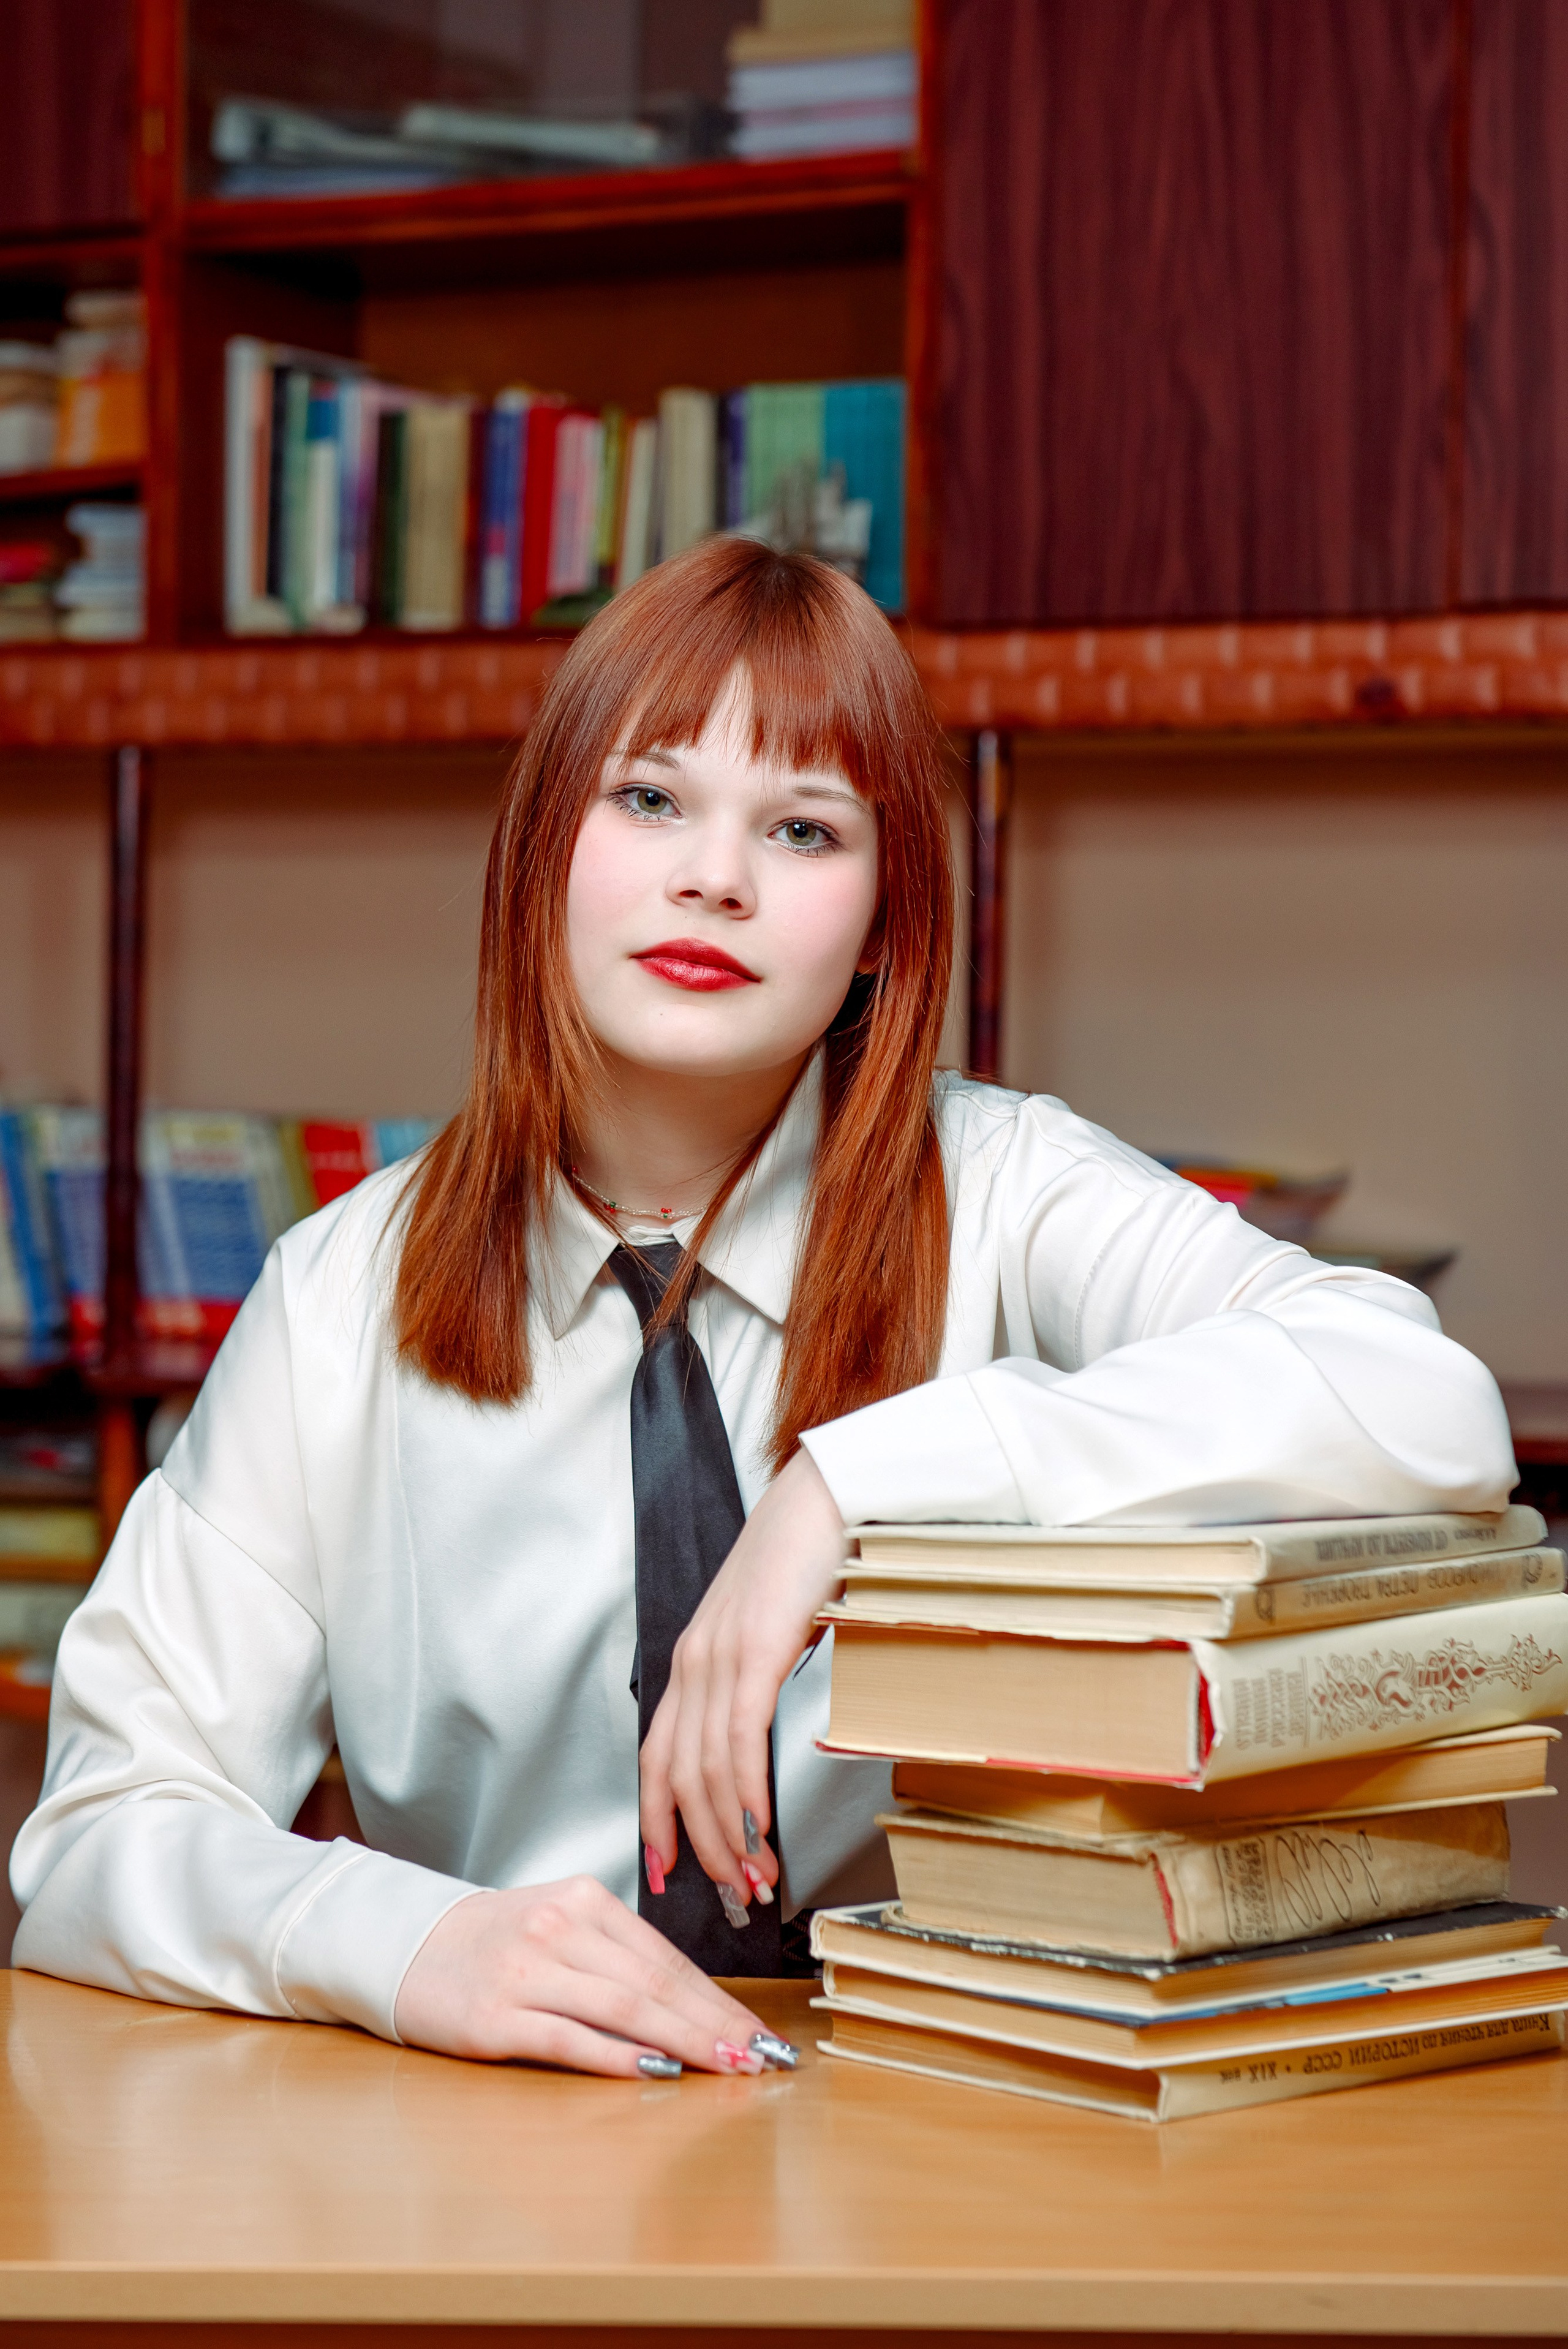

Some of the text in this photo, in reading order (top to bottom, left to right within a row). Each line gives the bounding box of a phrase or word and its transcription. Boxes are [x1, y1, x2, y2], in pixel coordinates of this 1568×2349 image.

[1220, 2013, 1551, 2084] Книга для чтения по ИСТОРИИ СССР XIX век
